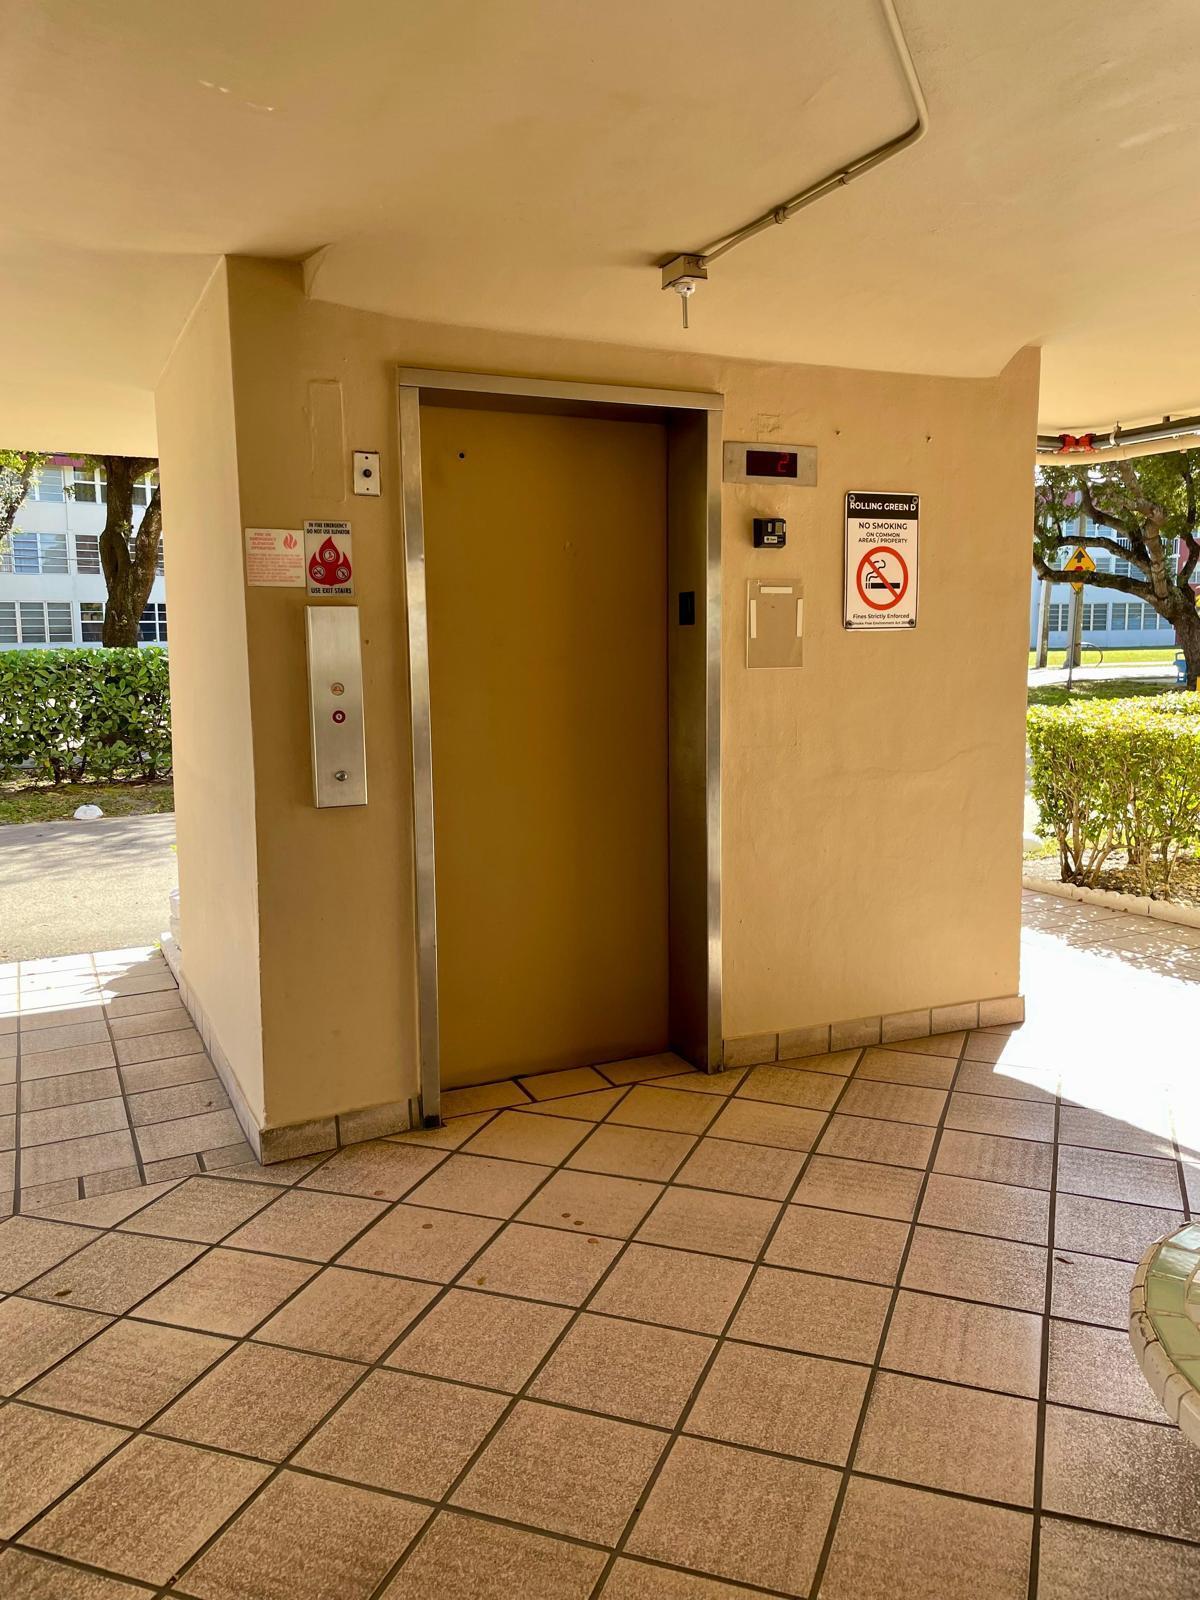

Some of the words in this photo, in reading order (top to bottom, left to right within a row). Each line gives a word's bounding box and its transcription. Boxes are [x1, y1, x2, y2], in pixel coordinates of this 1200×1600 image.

[777, 451, 789, 473] 2
[850, 502, 882, 510] ROLLING
[884, 503, 909, 511] GREEN
[872, 522, 908, 530] SMOKING
